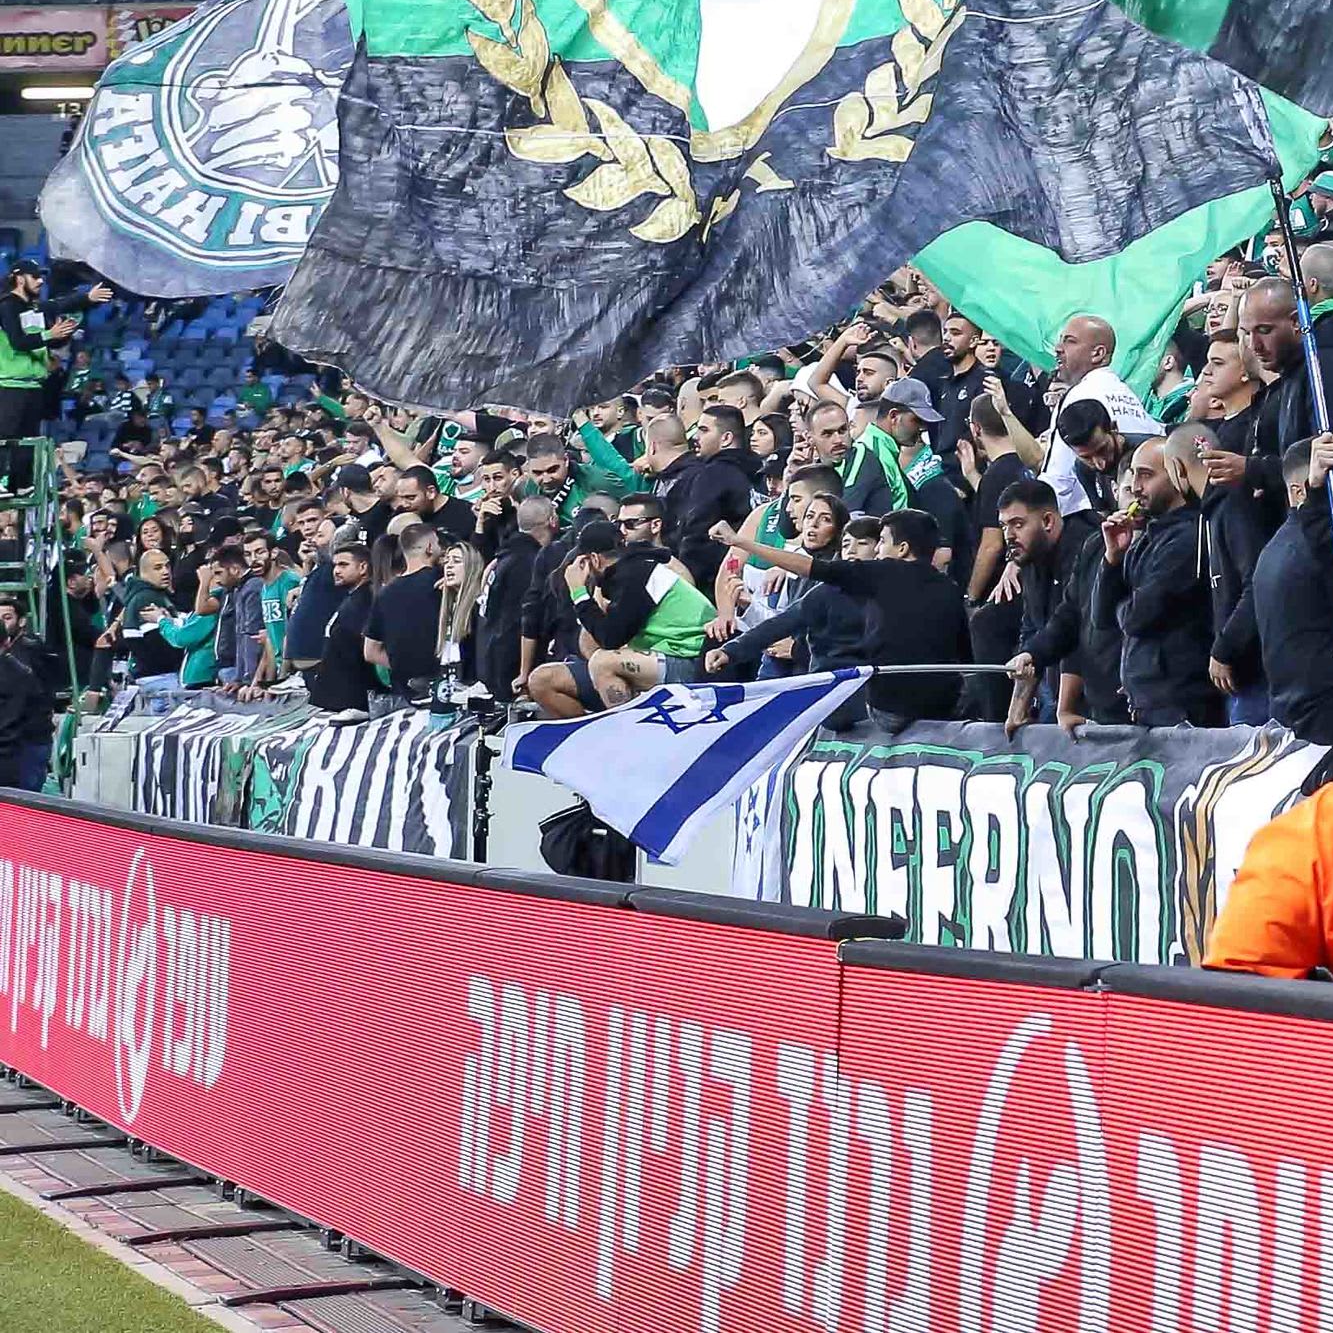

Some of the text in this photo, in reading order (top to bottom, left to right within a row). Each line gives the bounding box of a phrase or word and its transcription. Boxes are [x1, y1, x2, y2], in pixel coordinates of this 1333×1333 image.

[10, 862, 64, 1051] קניון
[789, 759, 1161, 968] INFERNO
[457, 972, 586, 1232] חיפה
[596, 1003, 754, 1333] קניון
